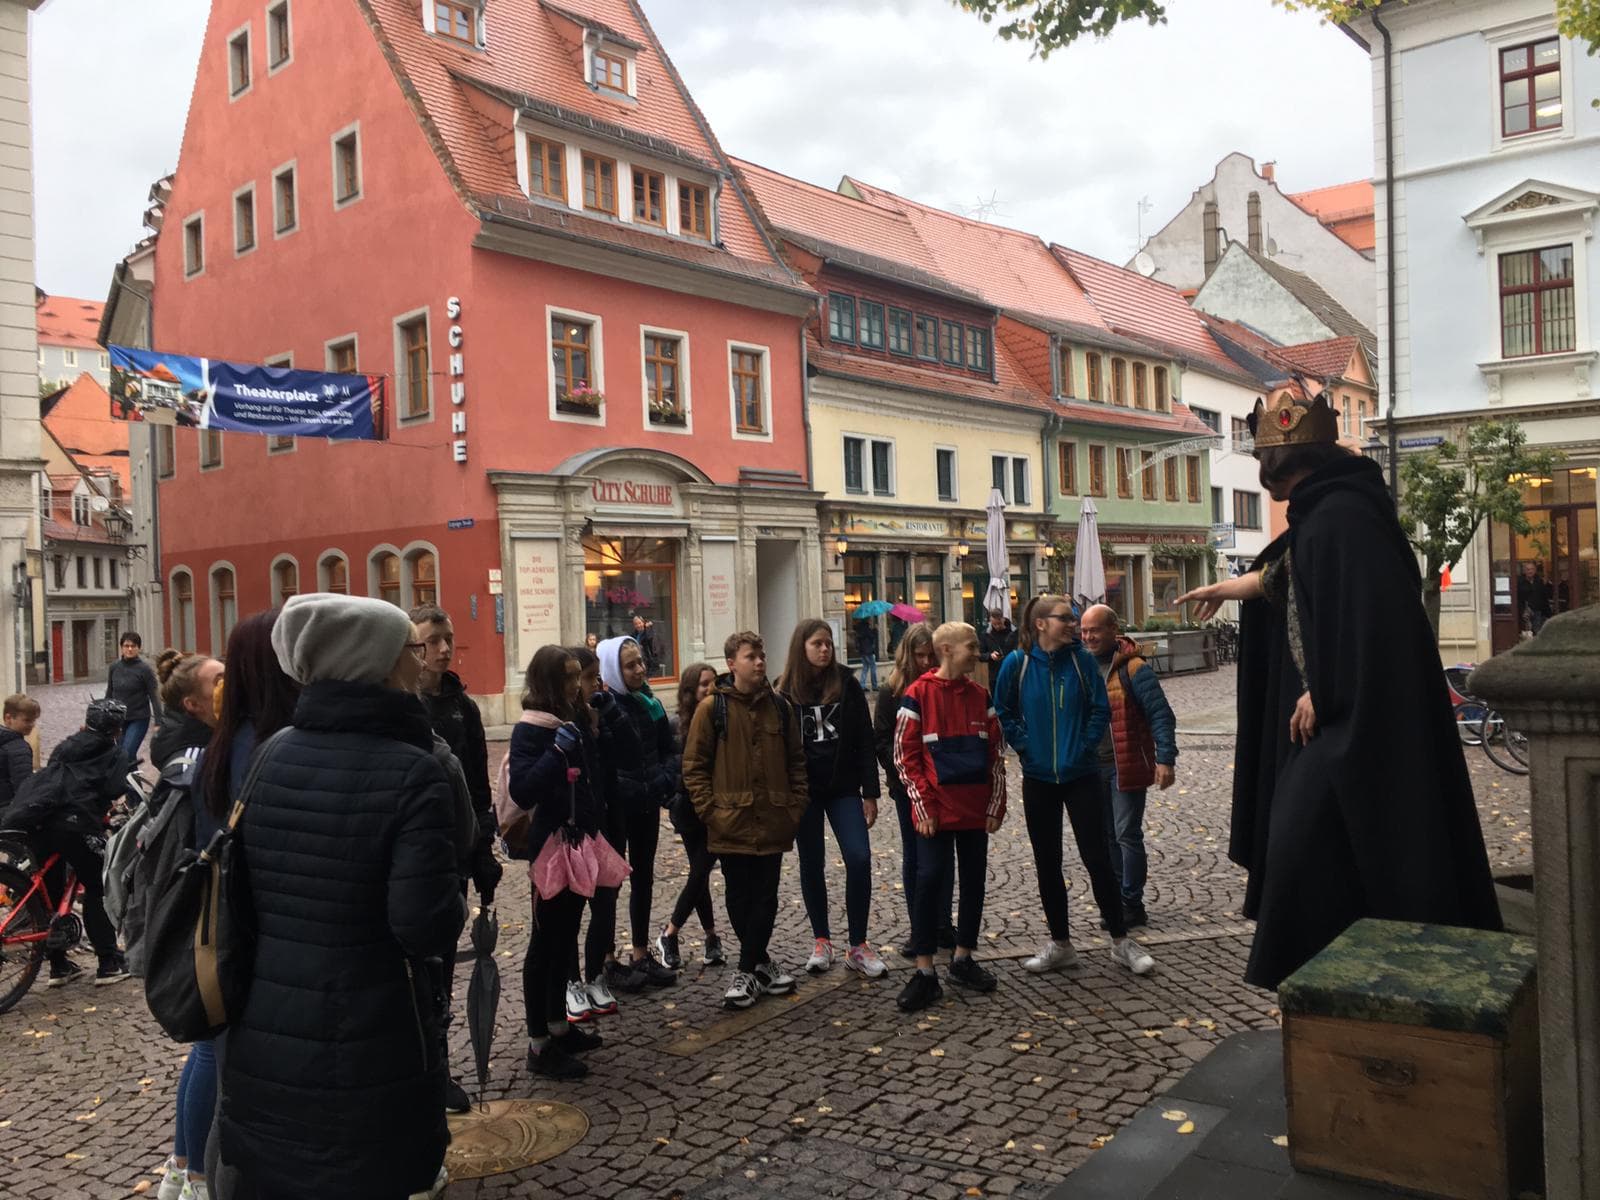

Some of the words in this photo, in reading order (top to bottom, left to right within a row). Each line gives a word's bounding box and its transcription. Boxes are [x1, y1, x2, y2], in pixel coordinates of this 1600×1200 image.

[446, 296, 467, 463] SCHUHE
[233, 383, 318, 402] Theaterplatz
[234, 402, 261, 412] Vorhang
[592, 479, 621, 503] CITY
[624, 480, 672, 505] SCHUHE
[905, 519, 944, 532] RISTORANTE
